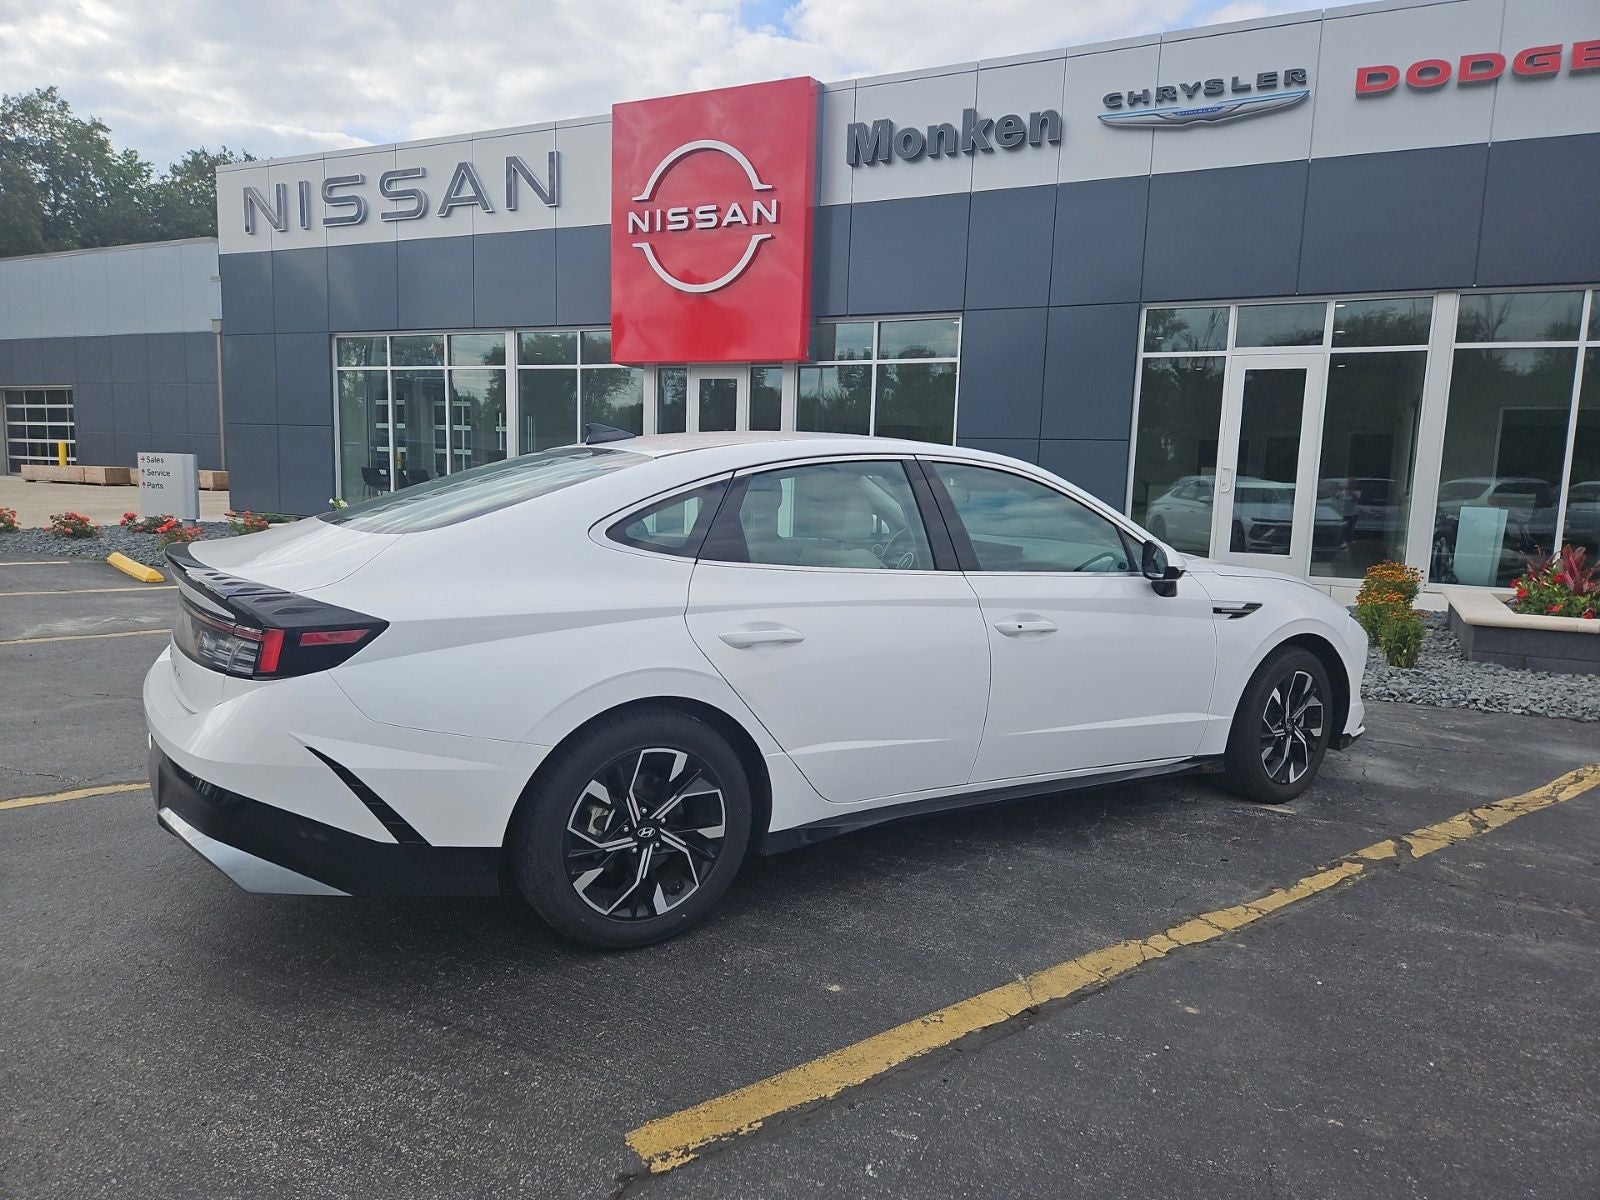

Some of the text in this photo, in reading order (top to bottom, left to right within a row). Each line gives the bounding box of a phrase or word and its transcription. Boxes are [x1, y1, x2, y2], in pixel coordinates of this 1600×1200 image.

[1355, 40, 1600, 98] DODGE
[1102, 68, 1308, 108] CHRYSLER
[846, 108, 1063, 167] Monken
[242, 150, 560, 234] NISSAN
[627, 199, 779, 234] NISSAN
[146, 455, 165, 464] Sales
[146, 468, 171, 477] Service
[147, 481, 164, 489] Parts
